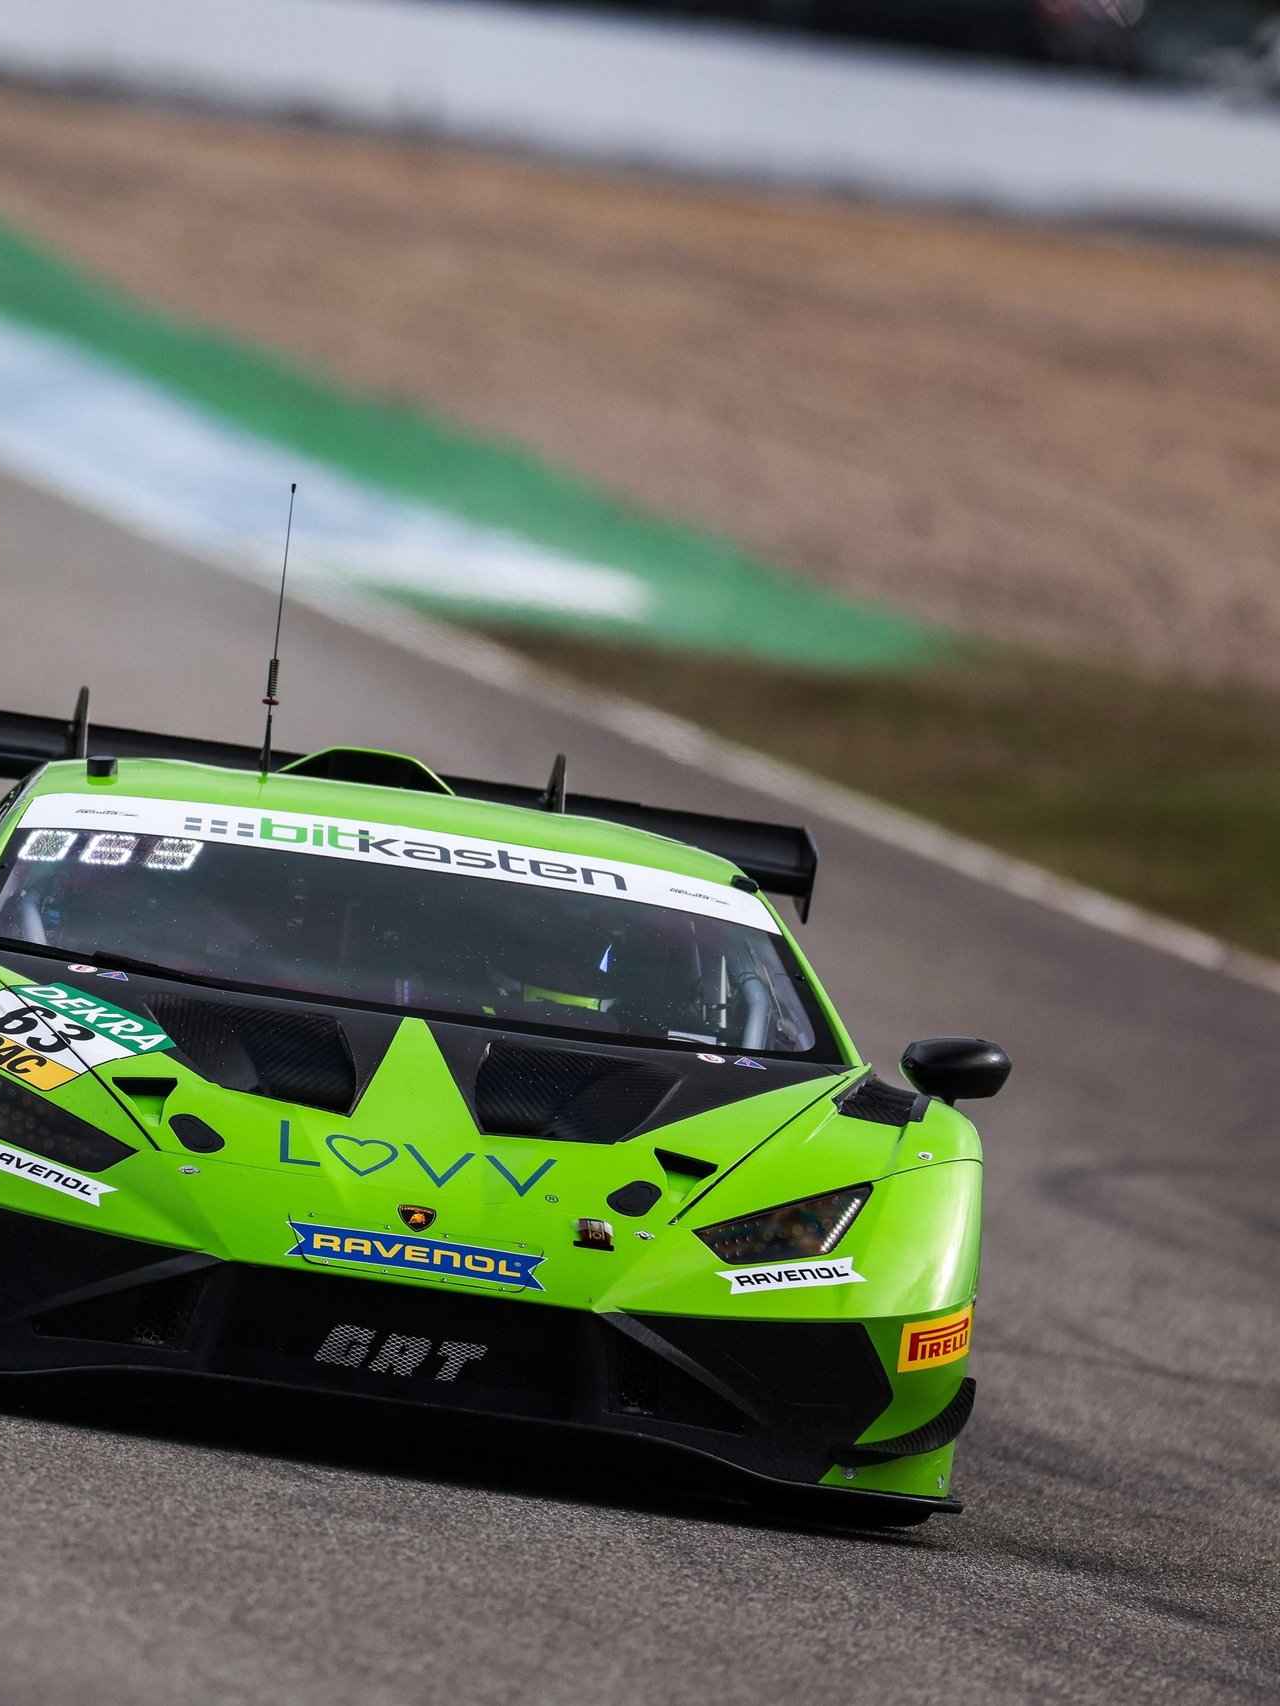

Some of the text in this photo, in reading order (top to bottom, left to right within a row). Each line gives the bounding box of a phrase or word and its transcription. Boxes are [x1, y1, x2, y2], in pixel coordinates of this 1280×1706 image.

[260, 817, 627, 891] bitkasten
[20, 986, 169, 1051] DEKRA
[312, 1233, 521, 1278] RAVENOL
[735, 1266, 850, 1288] RAVENOL
[313, 1324, 488, 1382] GRT
[908, 1316, 969, 1362] PIRELLI
